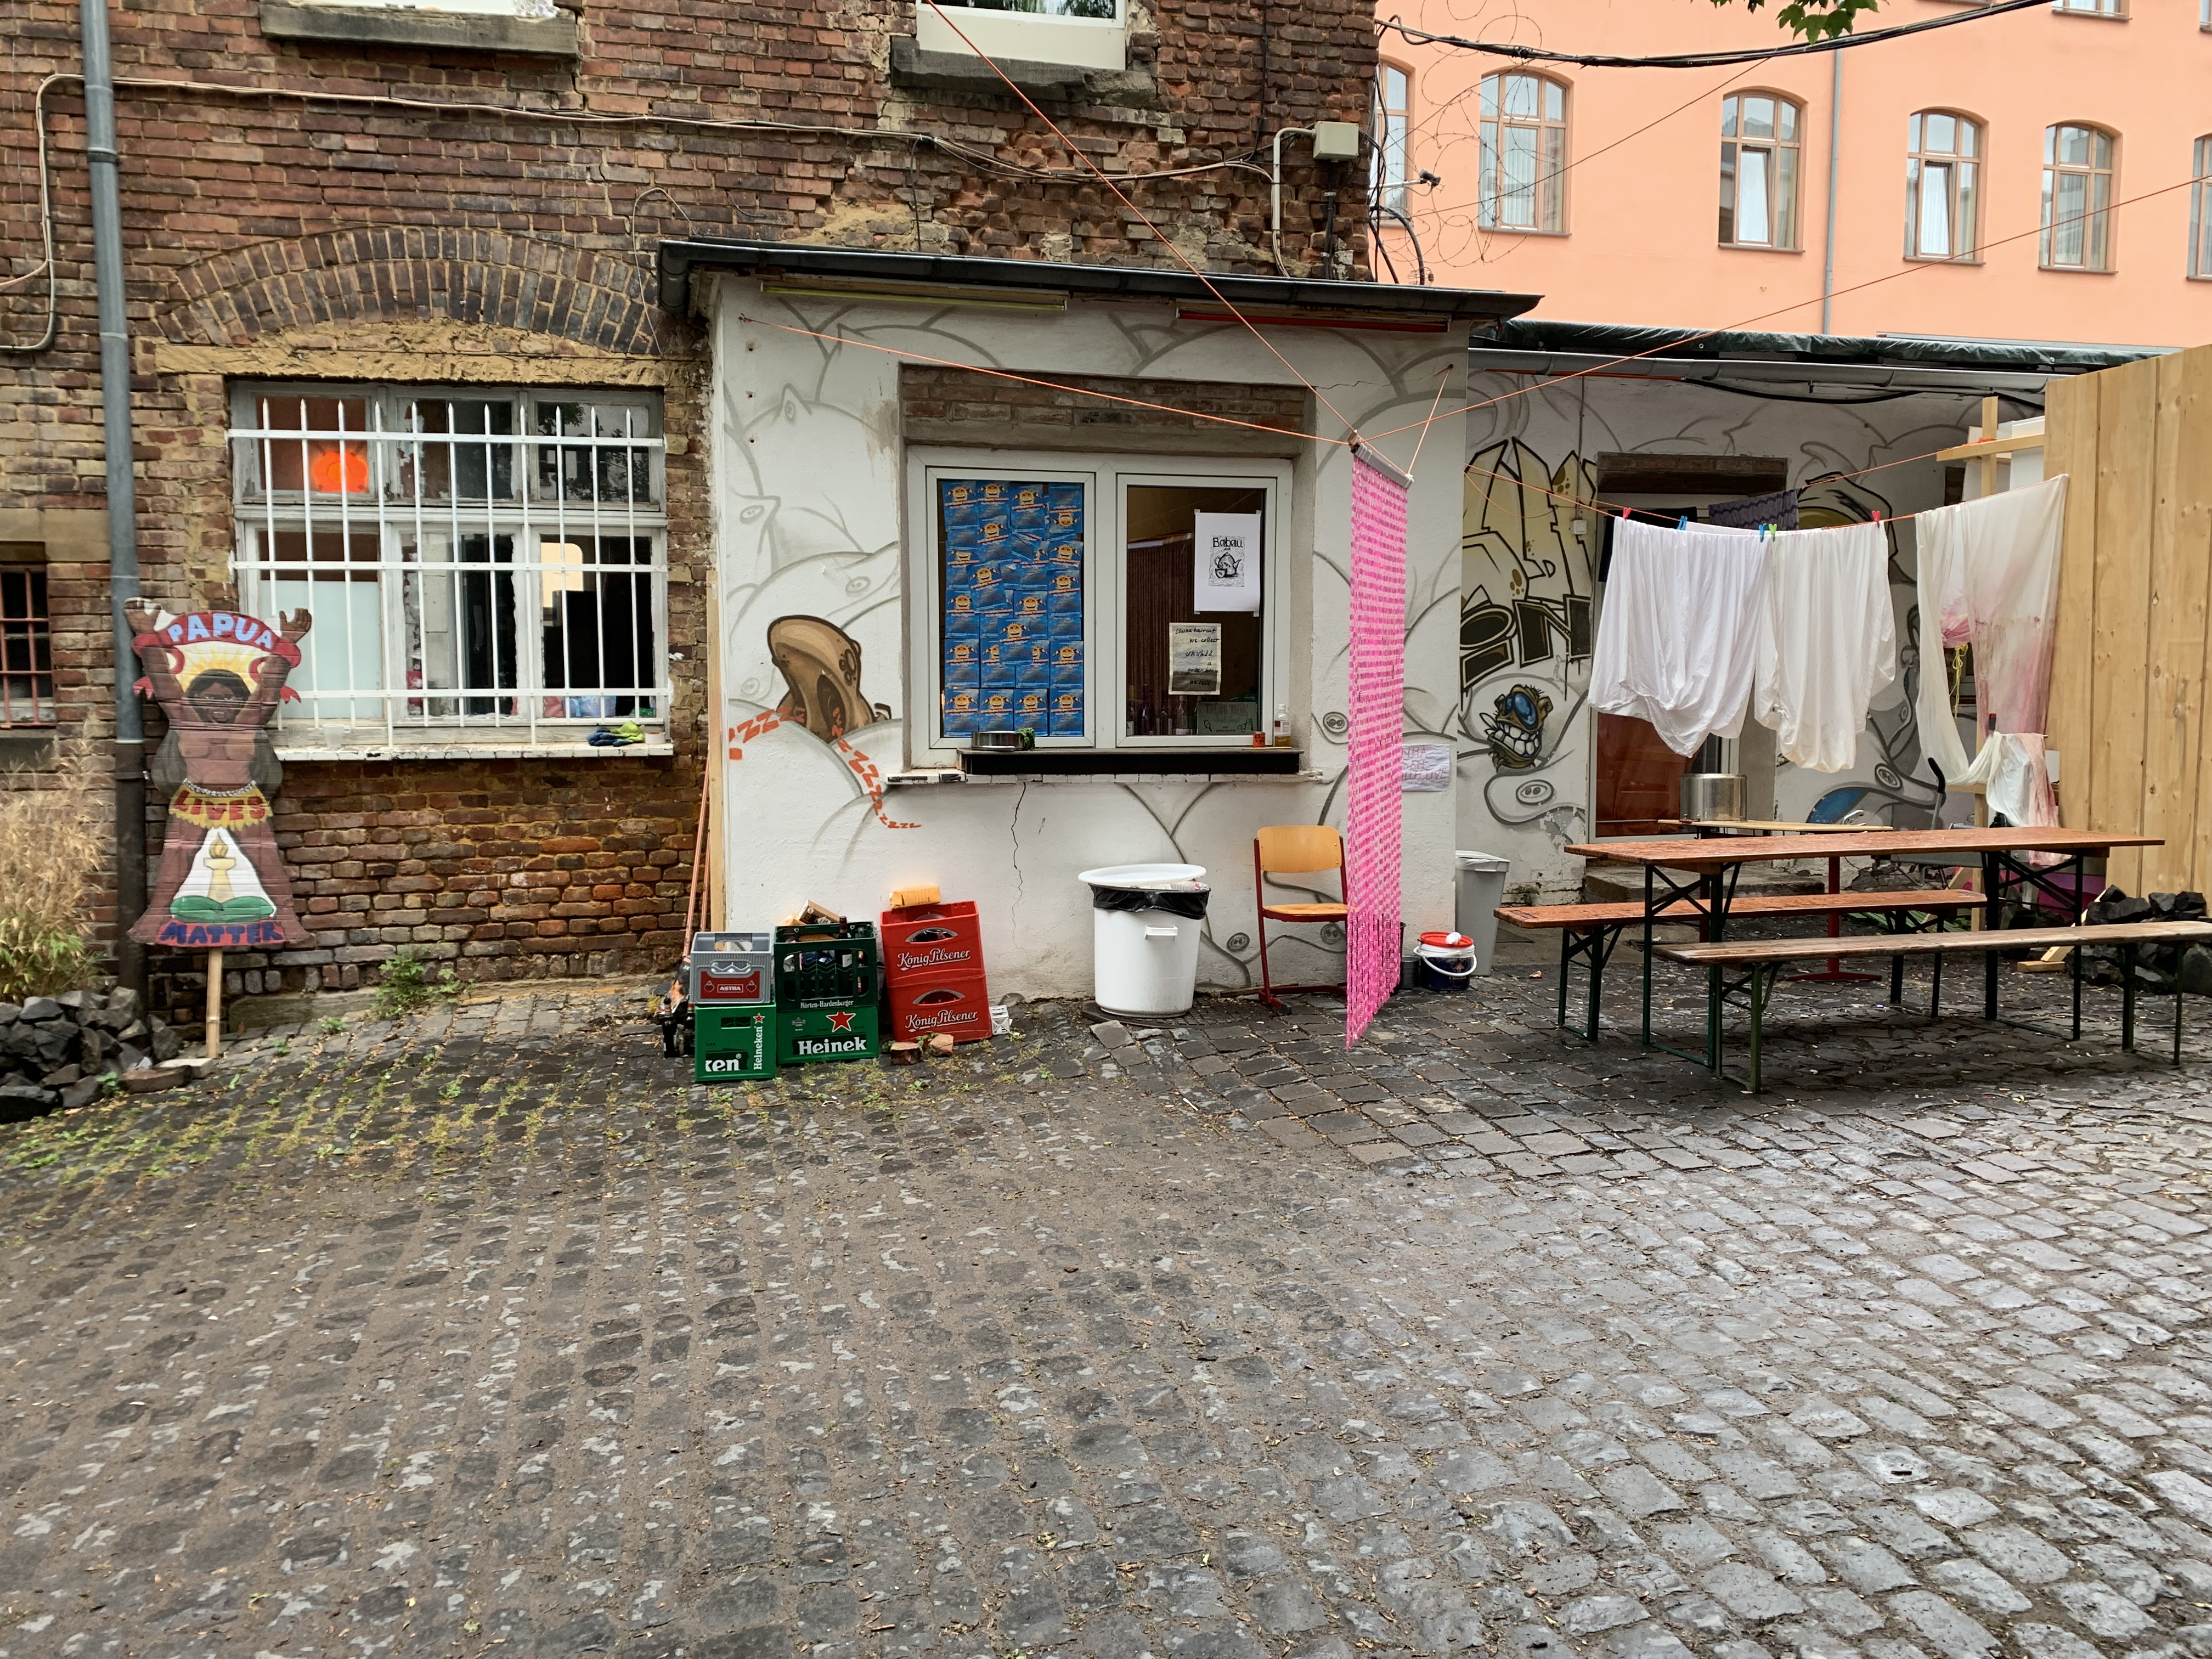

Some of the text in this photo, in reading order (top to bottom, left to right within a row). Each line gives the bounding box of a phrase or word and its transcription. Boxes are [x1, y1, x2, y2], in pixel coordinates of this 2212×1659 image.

[1212, 537, 1243, 548] Babau
[167, 613, 272, 650] PAPUA
[174, 789, 267, 821] LIVES
[160, 922, 284, 945] MATTER
[897, 947, 970, 967] König Pilsener
[905, 1013, 938, 1029] König
[937, 1009, 979, 1024] Pilsener
[753, 1026, 763, 1070] Heineken
[797, 1036, 867, 1056] Heinek
